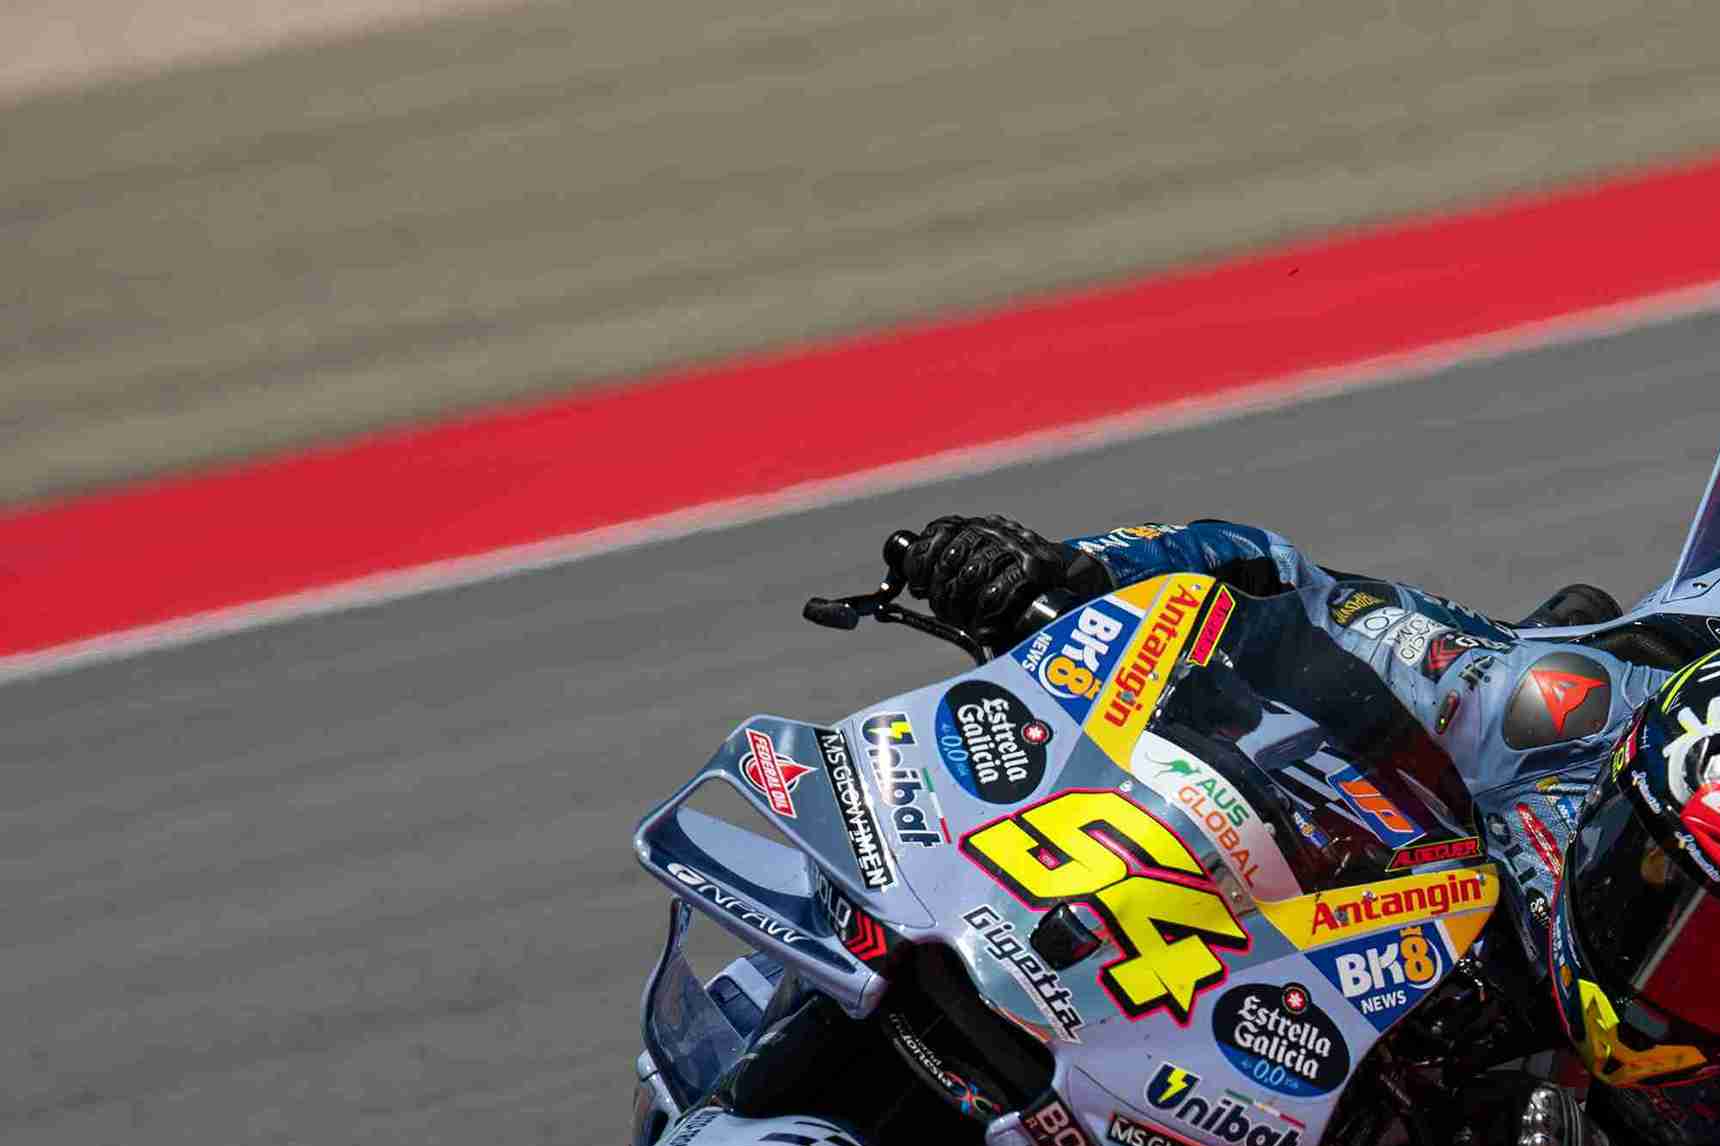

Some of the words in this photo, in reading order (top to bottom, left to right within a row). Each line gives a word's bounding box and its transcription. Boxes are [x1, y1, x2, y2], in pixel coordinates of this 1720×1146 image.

[1022, 632, 1052, 672] NEWS
[1045, 606, 1123, 696] BK8
[1104, 584, 1200, 727] Antangin
[752, 735, 782, 790] FEDERAL
[771, 787, 789, 812] OIL
[957, 704, 999, 784] Galicia
[983, 698, 1028, 782] Estrella
[861, 712, 943, 848] Unibat
[1196, 777, 1250, 827] AUS
[1178, 785, 1260, 888] GLOBAL
[962, 788, 1250, 1024] 54
[1311, 874, 1482, 935] Antangin
[963, 906, 1084, 1042] Gigetta
[1335, 932, 1436, 998] BK8
[1360, 990, 1408, 1015] NEWS
[1233, 1021, 1320, 1080] Galicia
[1236, 995, 1332, 1059] Estrella
